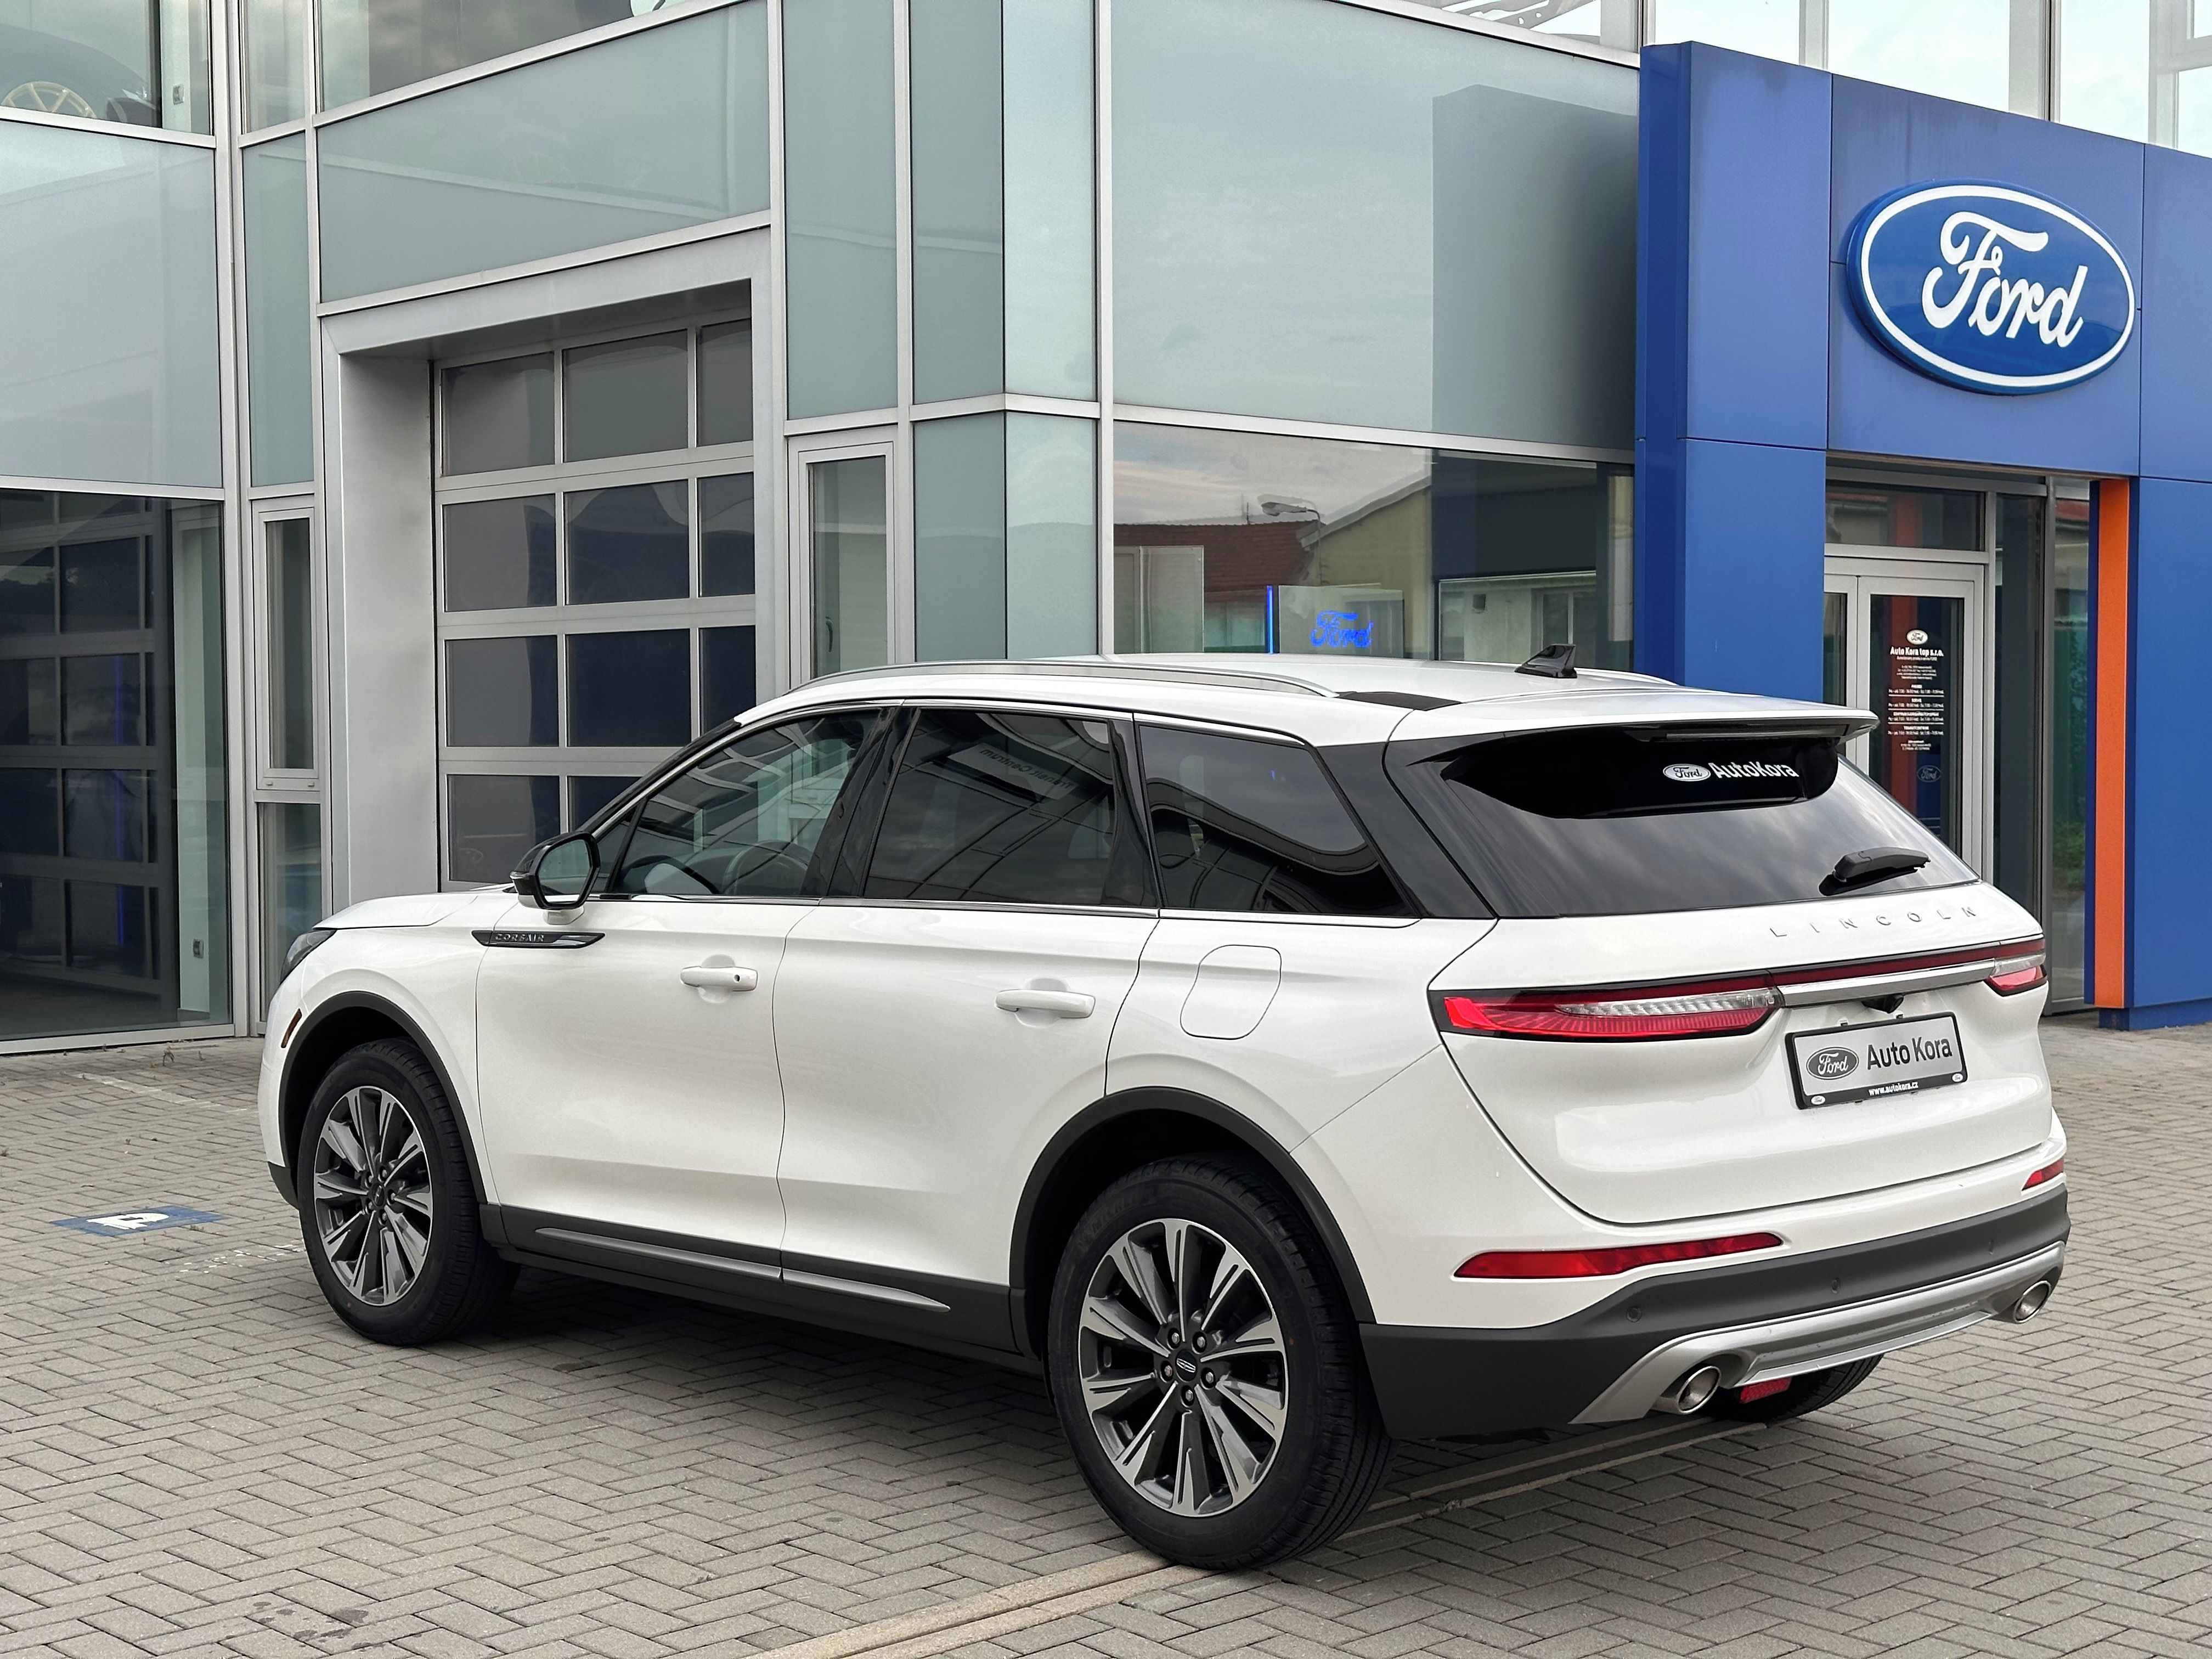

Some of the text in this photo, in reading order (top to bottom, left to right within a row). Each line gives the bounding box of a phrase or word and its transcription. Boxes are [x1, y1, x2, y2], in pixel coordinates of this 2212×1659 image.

[1922, 211, 2089, 348] Ford
[1310, 610, 1374, 648] Ford
[1890, 646, 1904, 655] Auto
[1905, 647, 1919, 656] Kora
[1920, 648, 1929, 657] top
[1673, 766, 1703, 778] Ford
[1770, 907, 1977, 937] LINCOLN
[495, 933, 544, 943] CORSAIR
[1817, 1036, 1953, 1075] Ford Auto Kora
[1868, 1081, 1919, 1096] www.autokora.cz
